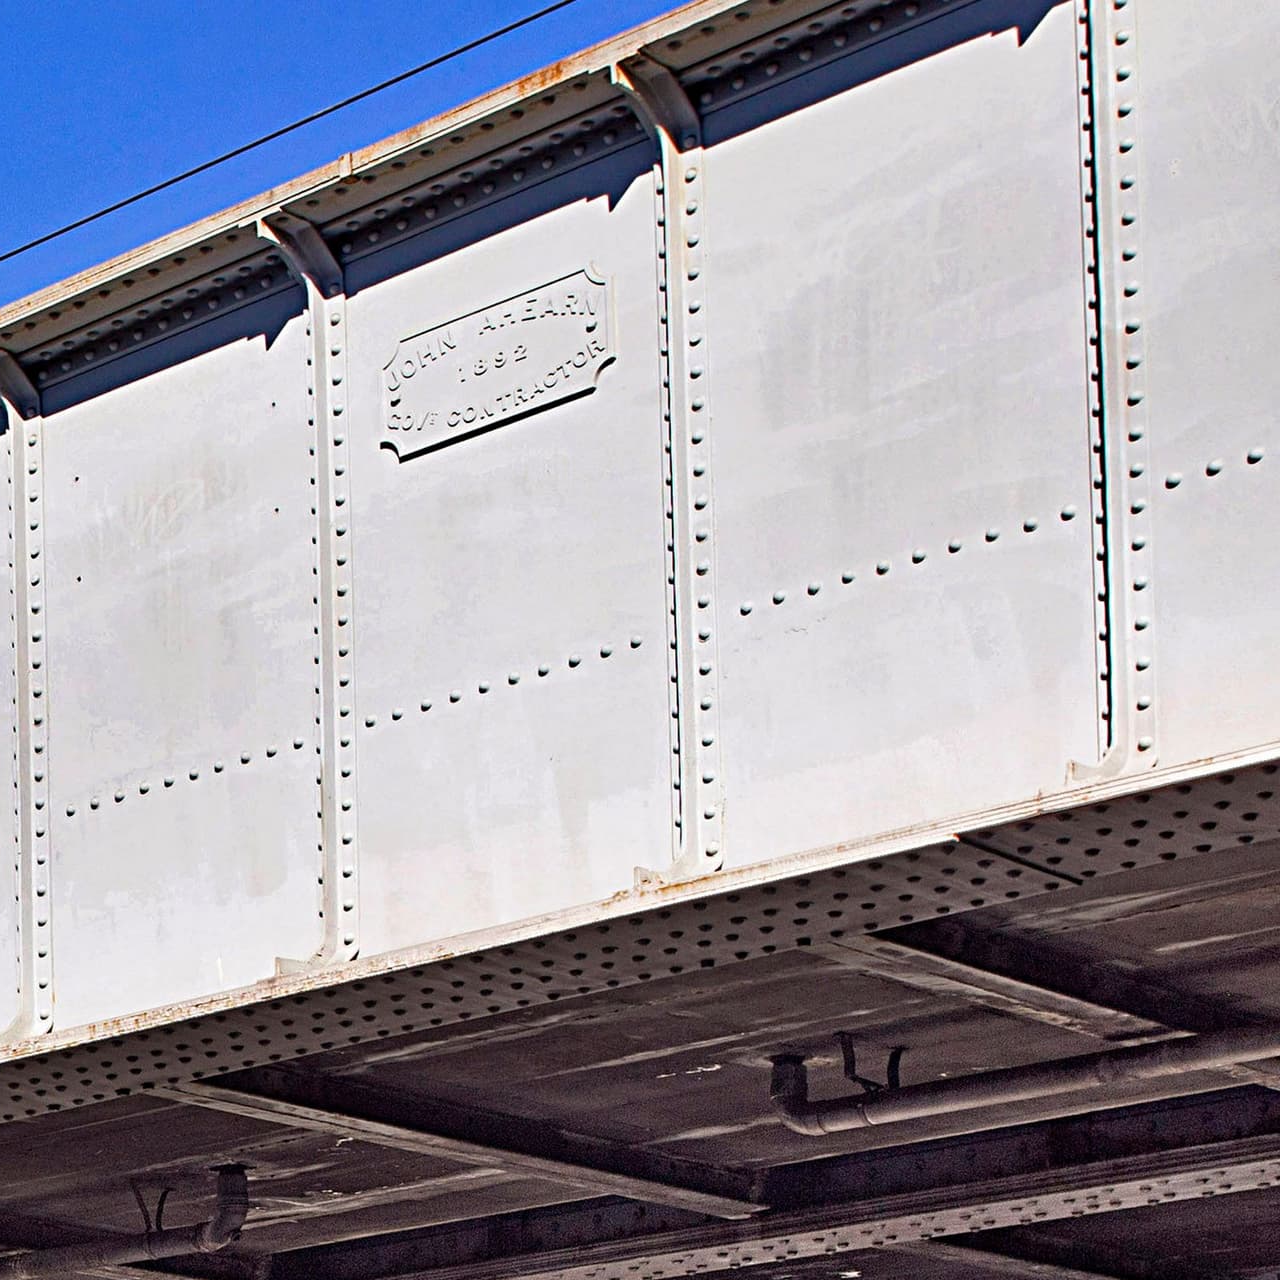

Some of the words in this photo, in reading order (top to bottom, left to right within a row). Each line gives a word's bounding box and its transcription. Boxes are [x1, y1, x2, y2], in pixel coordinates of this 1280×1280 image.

[386, 331, 457, 392] JOHN
[446, 339, 606, 428] CONTRACTOR
[458, 344, 528, 383] 1892
